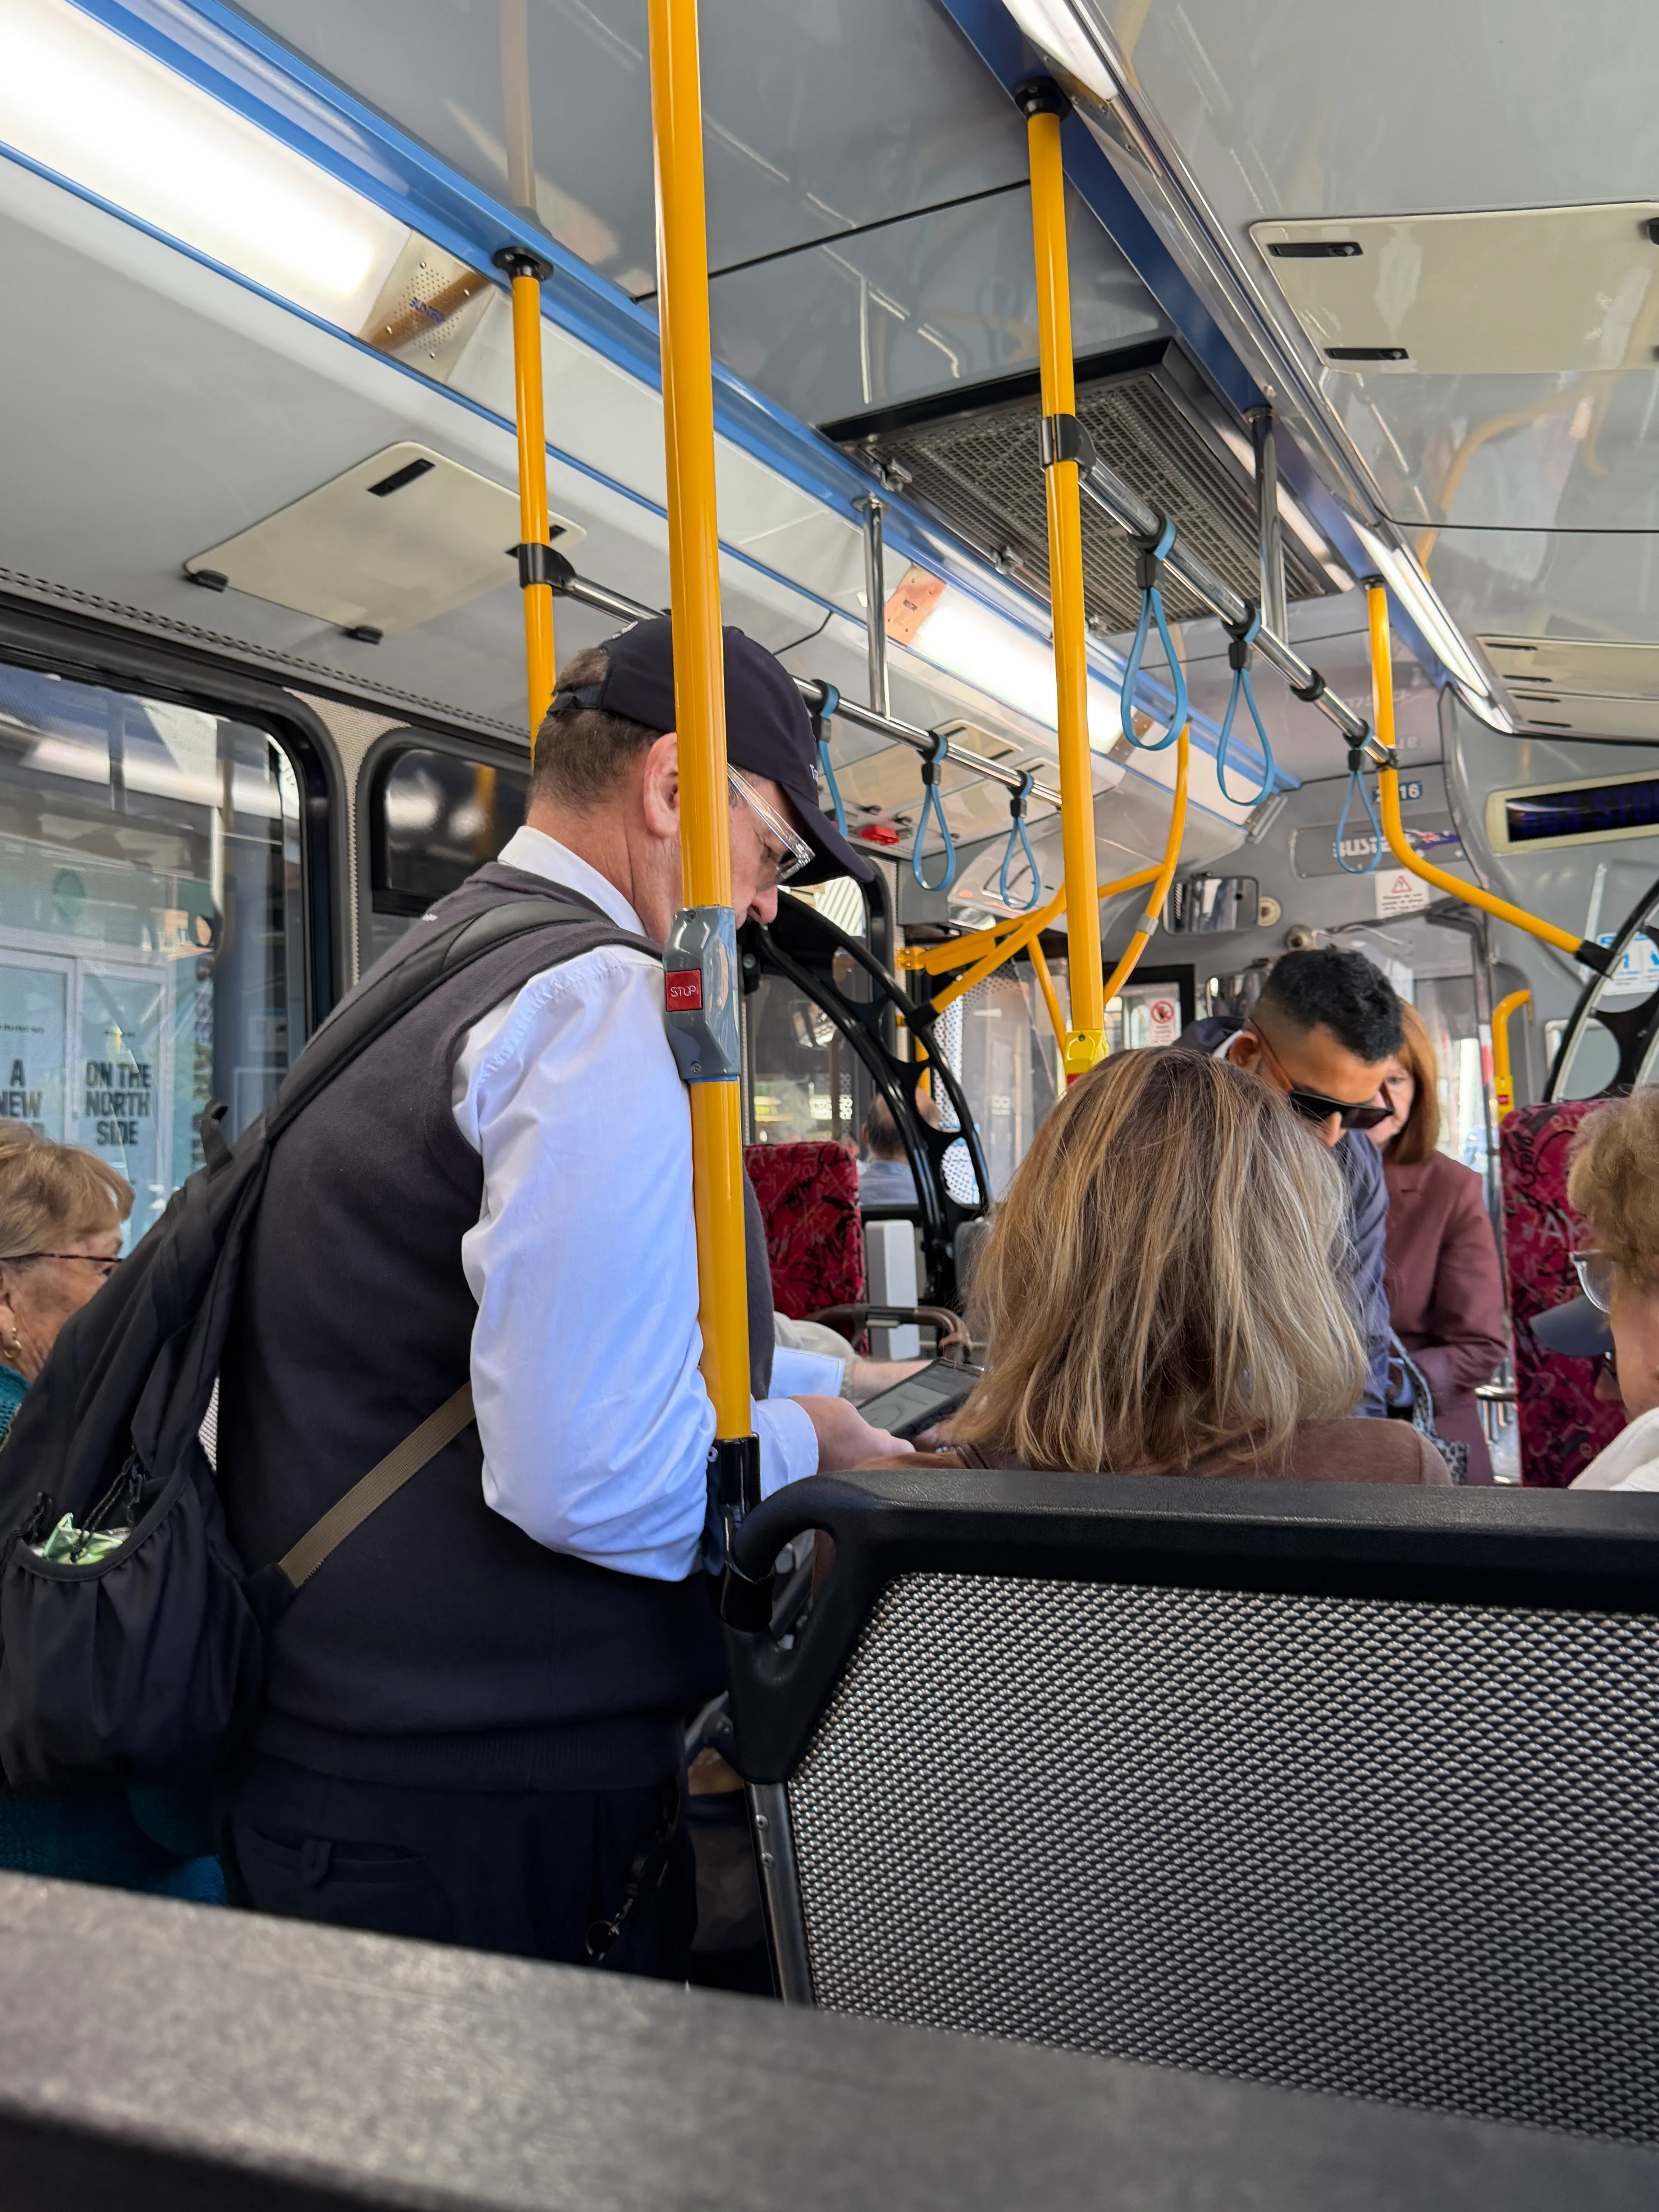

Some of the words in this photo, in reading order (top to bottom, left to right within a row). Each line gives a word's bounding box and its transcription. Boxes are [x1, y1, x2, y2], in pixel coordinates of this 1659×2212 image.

[670, 985, 696, 997] STOP
[11, 1059, 26, 1087] A
[86, 1061, 113, 1087] ON
[85, 1091, 150, 1116] NORTH
[96, 1120, 139, 1146] SIDE
